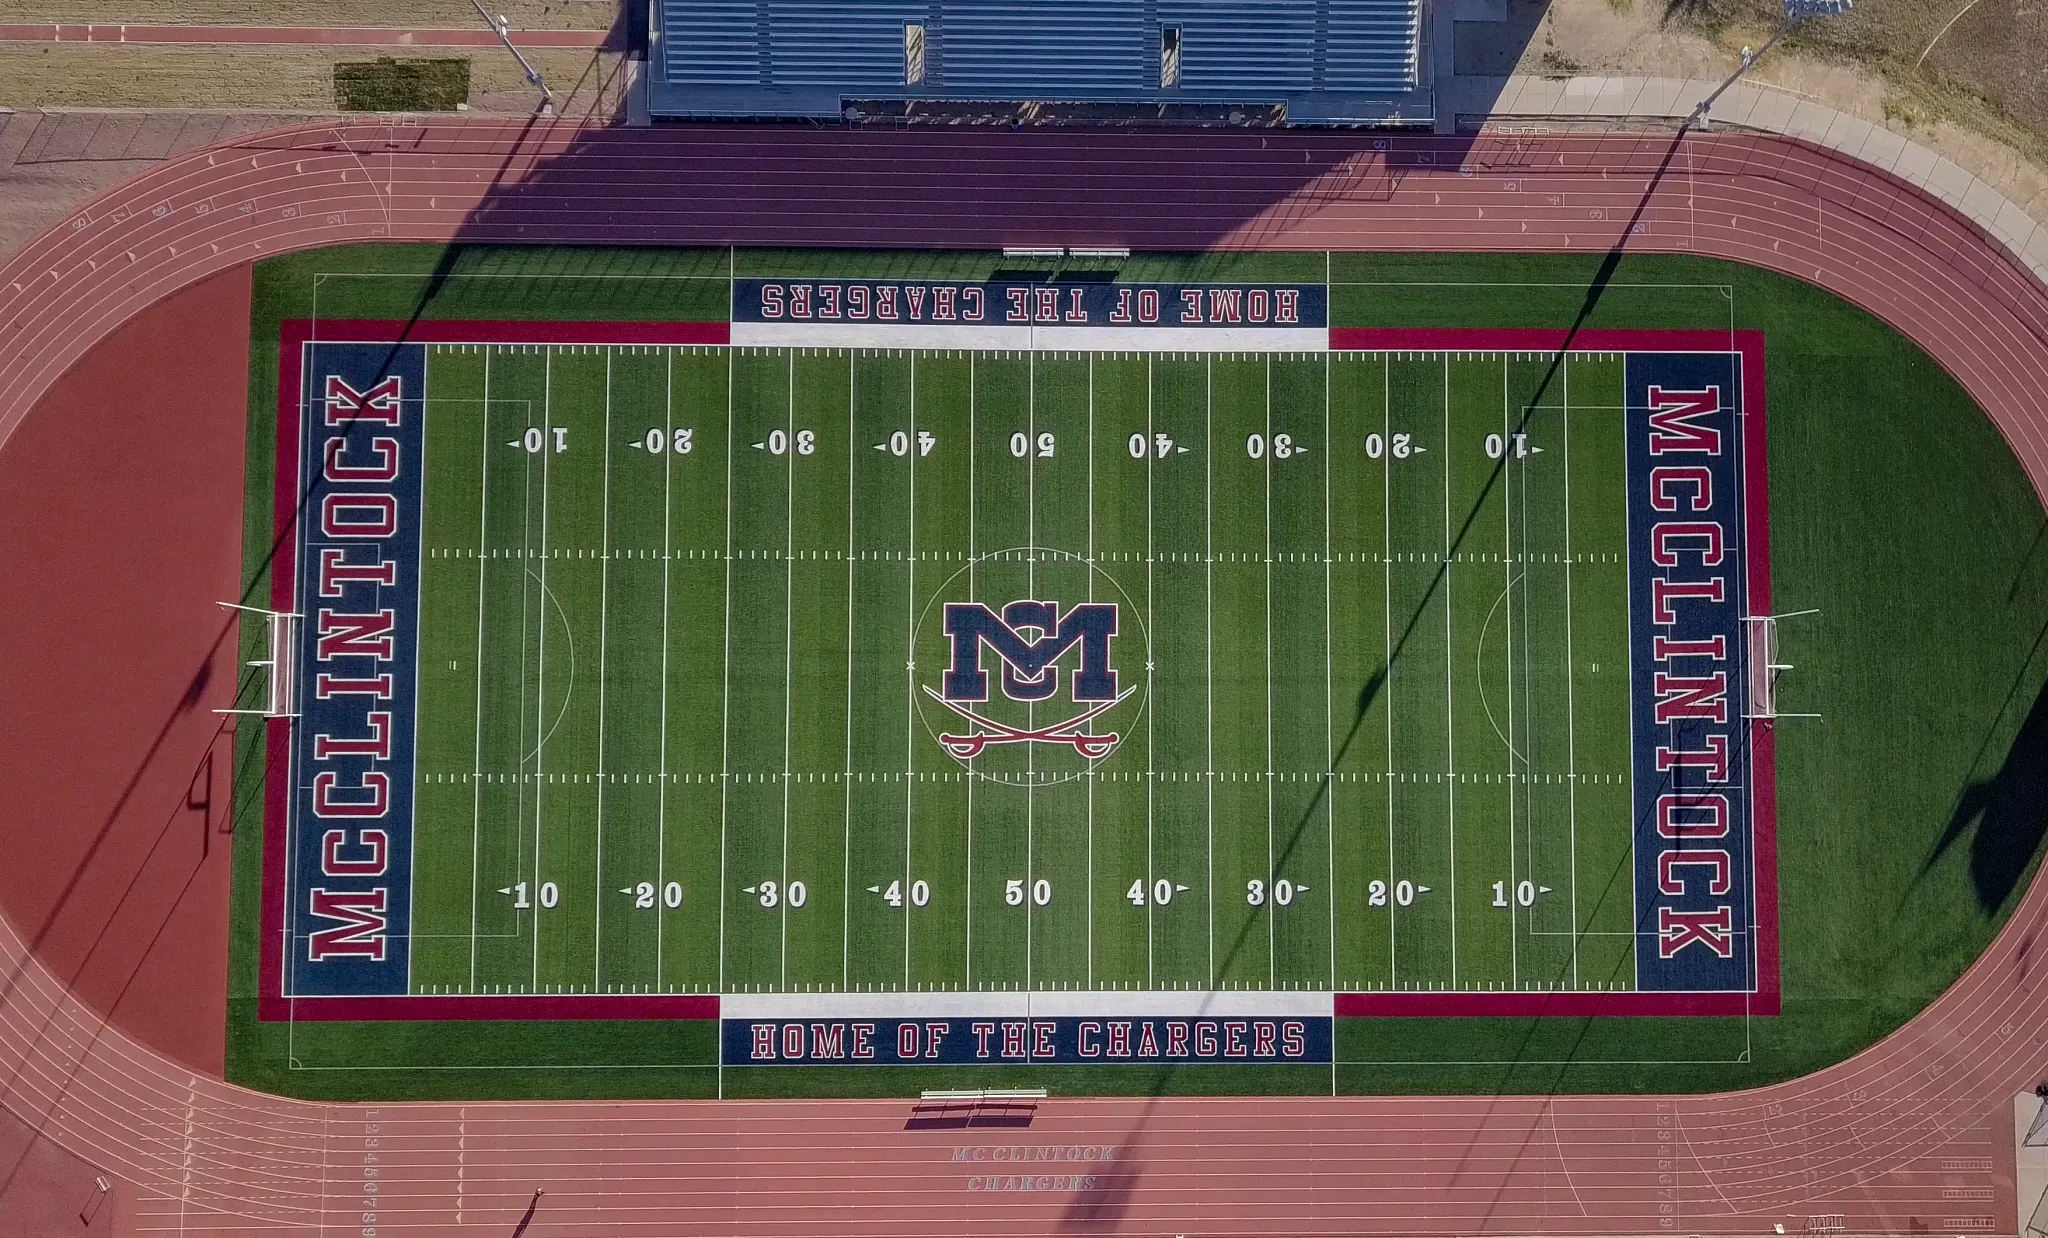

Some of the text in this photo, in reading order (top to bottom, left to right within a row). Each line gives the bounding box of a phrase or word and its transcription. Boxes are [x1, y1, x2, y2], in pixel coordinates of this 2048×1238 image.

[1373, 139, 1386, 150] 8
[1503, 180, 1517, 191] 5
[1546, 195, 1560, 206] 4
[152, 205, 166, 218] 6
[196, 203, 210, 215] 5
[238, 203, 252, 214] 4
[282, 207, 296, 218] 3
[1589, 209, 1603, 220] 3
[72, 217, 87, 230] 8
[111, 212, 125, 224] 7
[327, 214, 341, 225] 2
[1631, 223, 1646, 234] 2
[761, 284, 1299, 323] HOME OF THE CHARGERS
[523, 427, 568, 453] 10
[645, 428, 693, 454] 20
[768, 429, 815, 455] 30
[890, 430, 936, 456] 40
[1010, 432, 1055, 458] 50
[1128, 433, 1173, 459] 40
[1246, 433, 1292, 459] 30
[1365, 433, 1411, 459] 20
[1484, 433, 1528, 459] 10
[513, 881, 559, 909] 10
[635, 881, 683, 908] 20
[759, 881, 807, 908] 30
[883, 879, 930, 907] 40
[1005, 879, 1052, 906] 50
[1126, 879, 1172, 906] 40
[1246, 879, 1293, 907] 30
[1368, 879, 1414, 907] 20
[1492, 880, 1535, 907] 10
[751, 1021, 1305, 1059] HOME OF THE CHARGERS
[1656, 1102, 1669, 1111] 1
[366, 1109, 379, 1118] 1
[1656, 1116, 1671, 1127] 2
[365, 1123, 379, 1134] 2
[1657, 1130, 1671, 1141] 3
[365, 1138, 379, 1148] 3
[1657, 1145, 1671, 1156] 4
[364, 1152, 378, 1164] 4
[1658, 1159, 1672, 1169] 5
[363, 1167, 378, 1177] 5
[966, 1175, 1097, 1191] CHARGERS
[1658, 1174, 1673, 1184] 6
[363, 1182, 378, 1193] 6
[1658, 1188, 1673, 1199] 7
[362, 1197, 377, 1208] 7
[1659, 1203, 1673, 1213] 8
[362, 1212, 376, 1222] 8
[1660, 1218, 1674, 1228] 9
[362, 1227, 376, 1237] 9
